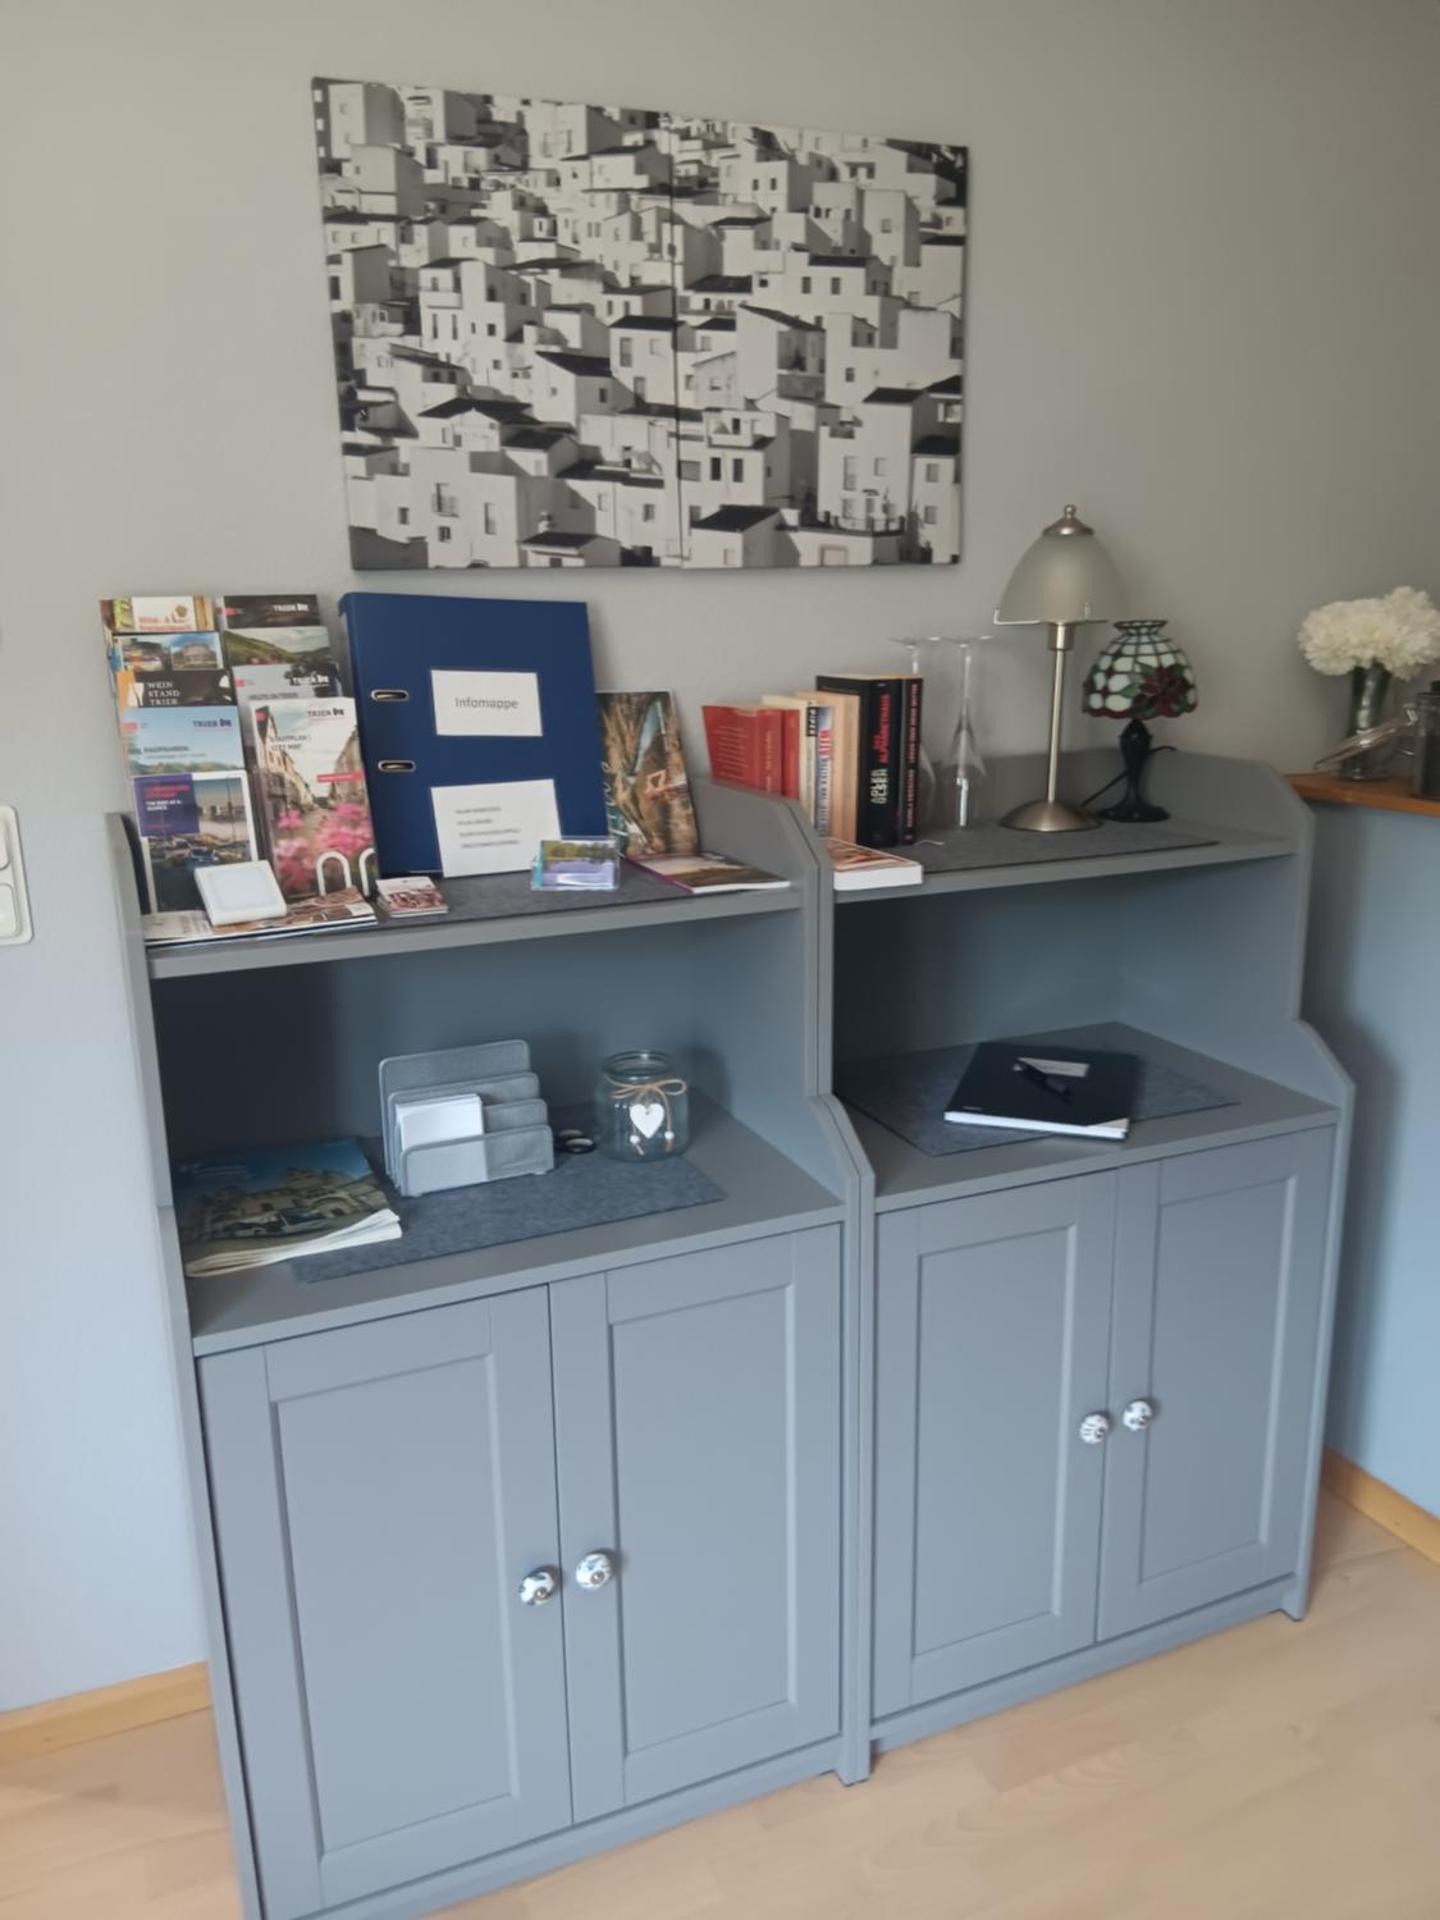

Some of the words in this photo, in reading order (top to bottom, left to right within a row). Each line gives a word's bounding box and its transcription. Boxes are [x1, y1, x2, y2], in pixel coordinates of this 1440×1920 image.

[146, 681, 173, 689] WEIN
[147, 690, 180, 698] STAND
[149, 698, 178, 706] TRIER
[455, 696, 519, 711] Infomappe
[192, 720, 218, 728] TRIER
